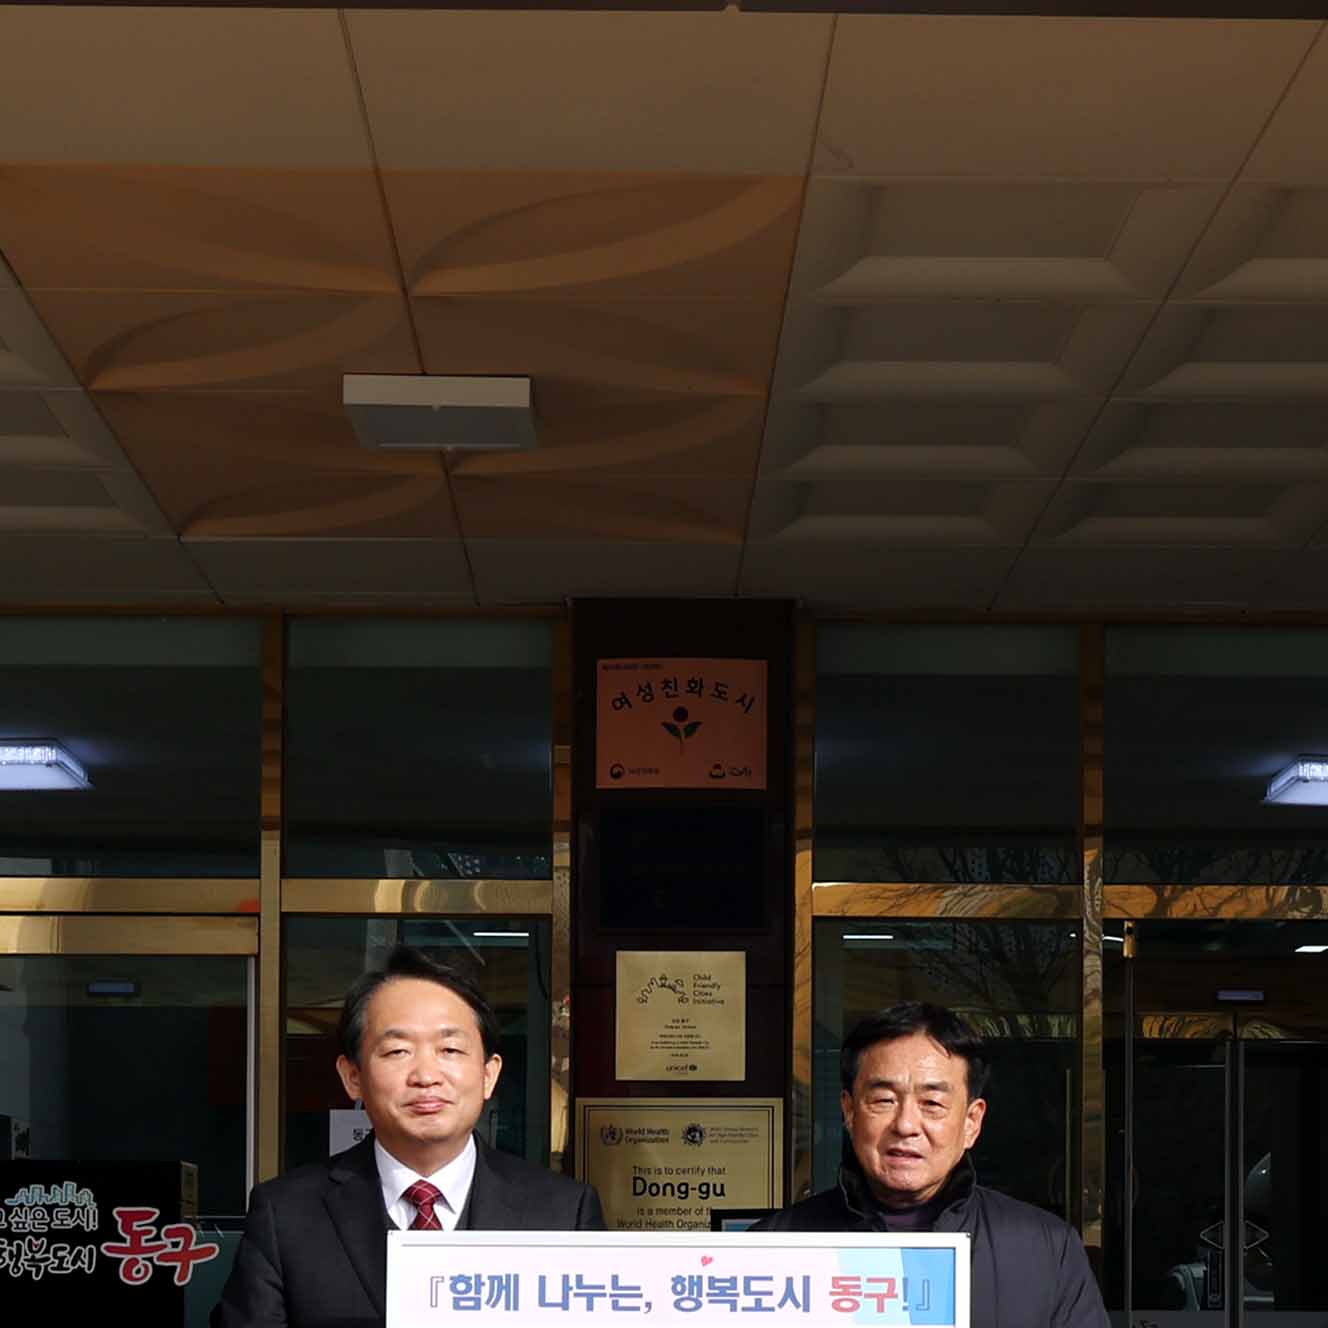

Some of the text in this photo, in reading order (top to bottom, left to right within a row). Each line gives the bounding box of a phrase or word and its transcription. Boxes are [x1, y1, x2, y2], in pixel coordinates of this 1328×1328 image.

[611, 677, 755, 713] 여성친화도시
[632, 1166, 726, 1177] This is to certify that
[632, 1176, 725, 1200] Dong-gu
[8, 1206, 50, 1232] 싶은
[50, 1206, 99, 1232] 도시!
[616, 1218, 642, 1229] World
[645, 1218, 673, 1229] Health
[637, 1206, 645, 1216] is
[656, 1206, 686, 1216] member
[694, 1206, 704, 1216] of
[100, 1205, 220, 1286] 동구
[537, 1274, 652, 1314] 나누는,
[670, 1274, 811, 1312] 행복도시
